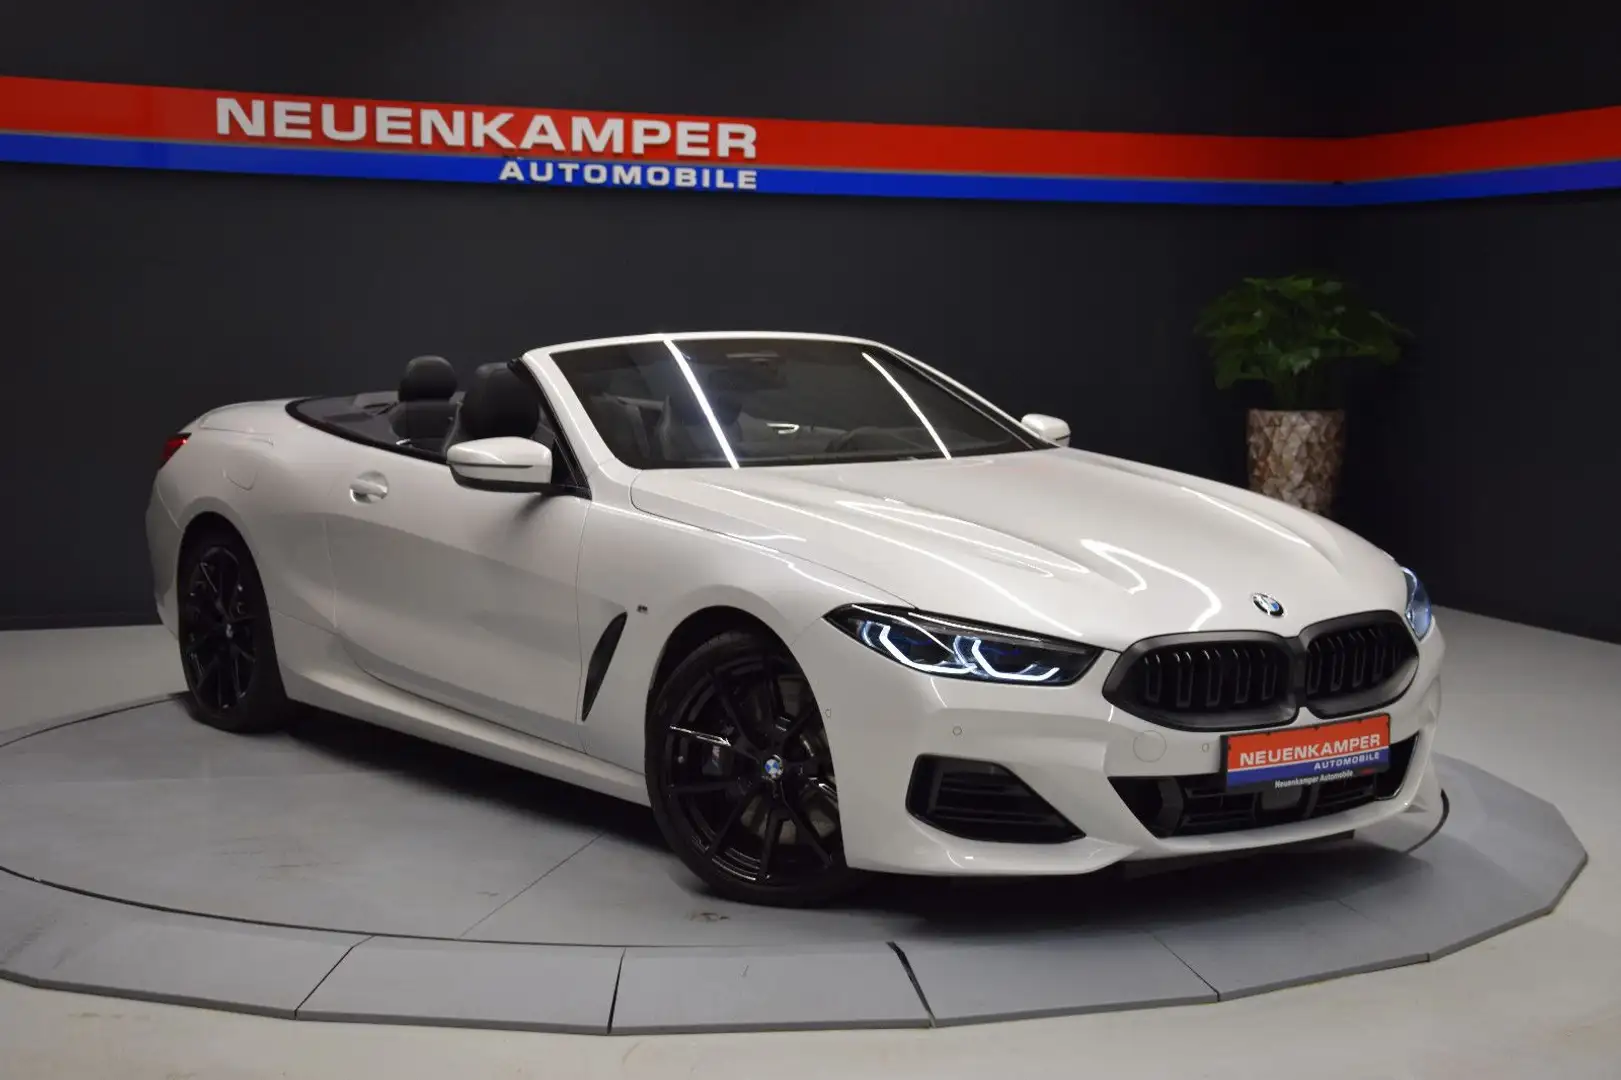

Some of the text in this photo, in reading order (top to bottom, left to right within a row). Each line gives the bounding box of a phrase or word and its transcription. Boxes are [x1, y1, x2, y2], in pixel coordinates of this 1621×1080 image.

[216, 97, 757, 159] NEUENKAMPER
[499, 160, 758, 189] AUTOMOBILE
[1240, 734, 1380, 766] NEUENKAMPER
[1314, 752, 1380, 770] AUTOMOBILE
[1274, 769, 1354, 789] Neuenkamper Automobile
